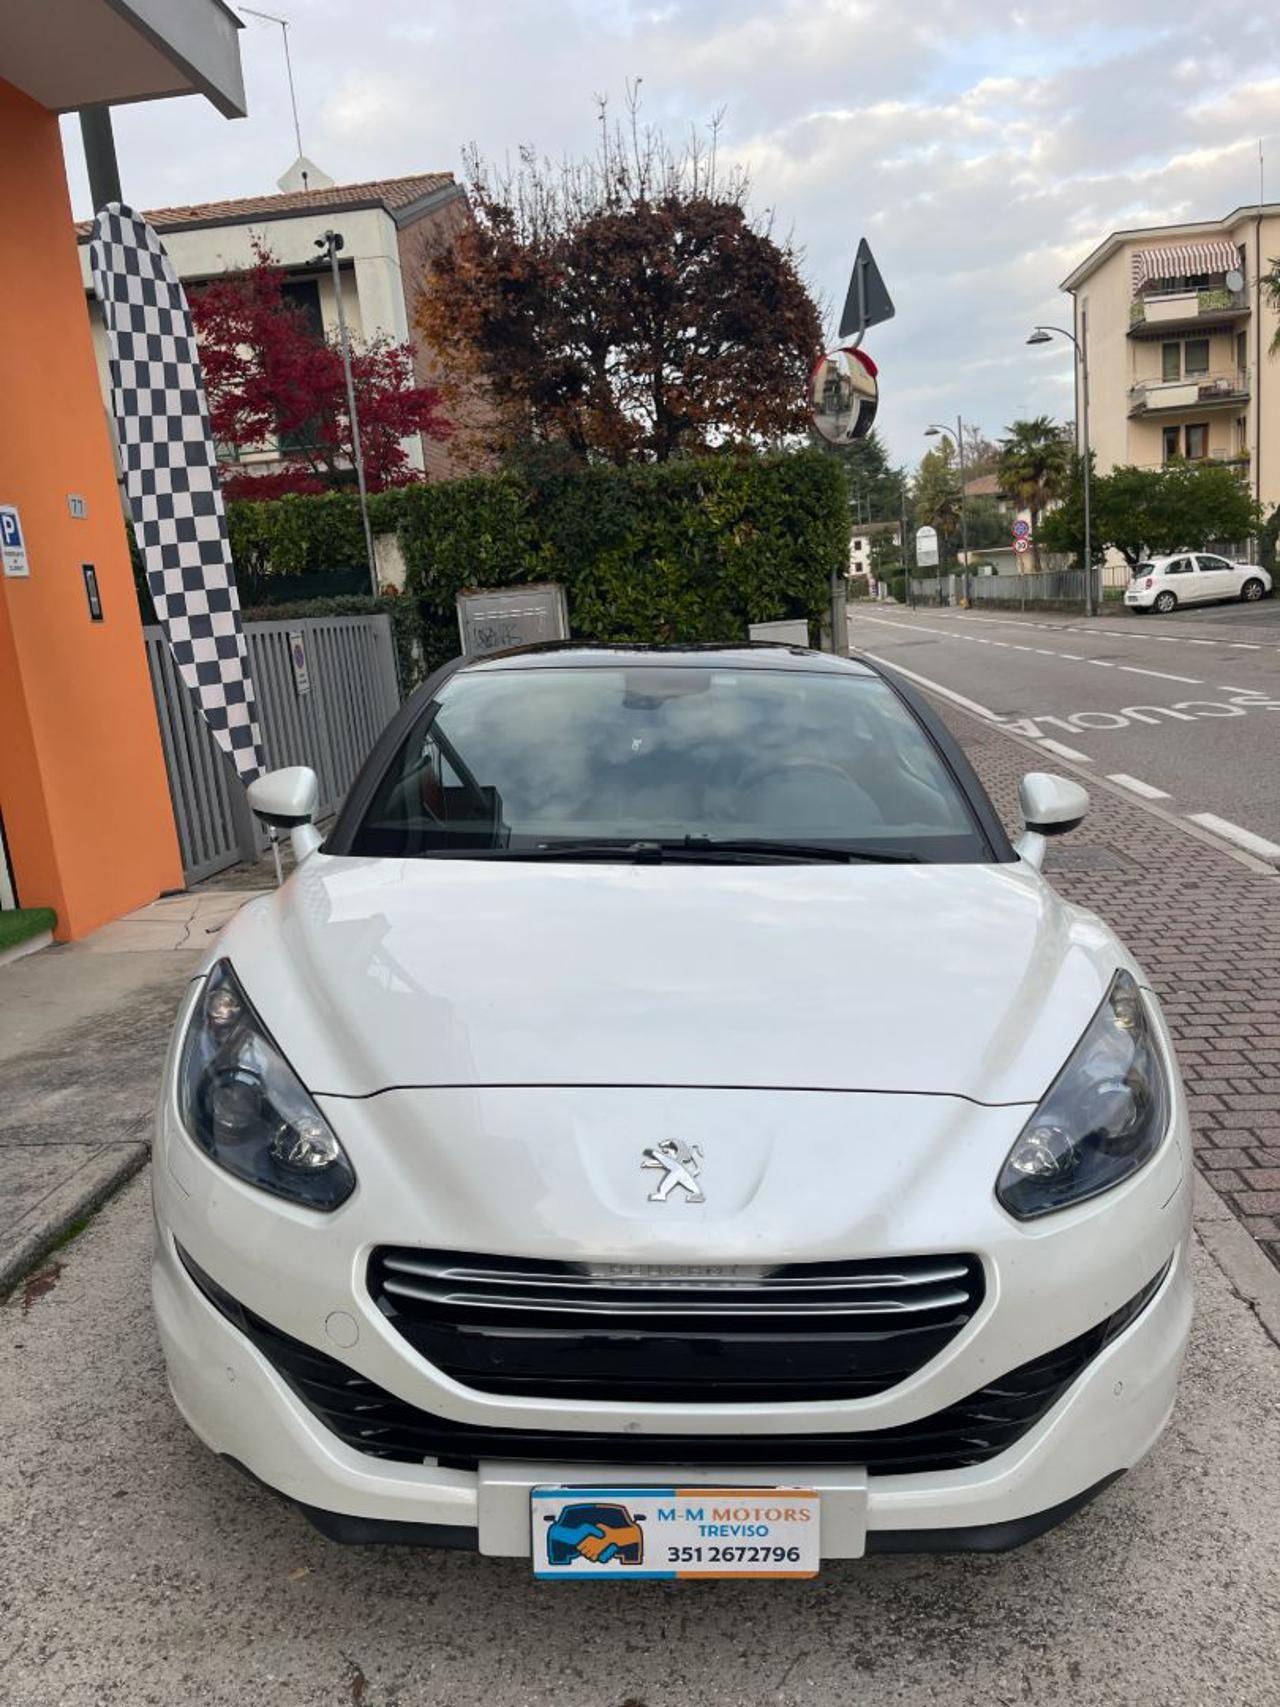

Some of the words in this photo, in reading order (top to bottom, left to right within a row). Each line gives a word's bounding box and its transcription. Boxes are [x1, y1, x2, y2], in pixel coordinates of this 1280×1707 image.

[71, 499, 83, 514] 77
[2, 515, 15, 544] P
[658, 1508, 704, 1521] M-M
[712, 1508, 810, 1522] MOTORS
[698, 1525, 769, 1537] TREVISO
[667, 1547, 703, 1562] 351
[708, 1547, 801, 1562] 2672796
